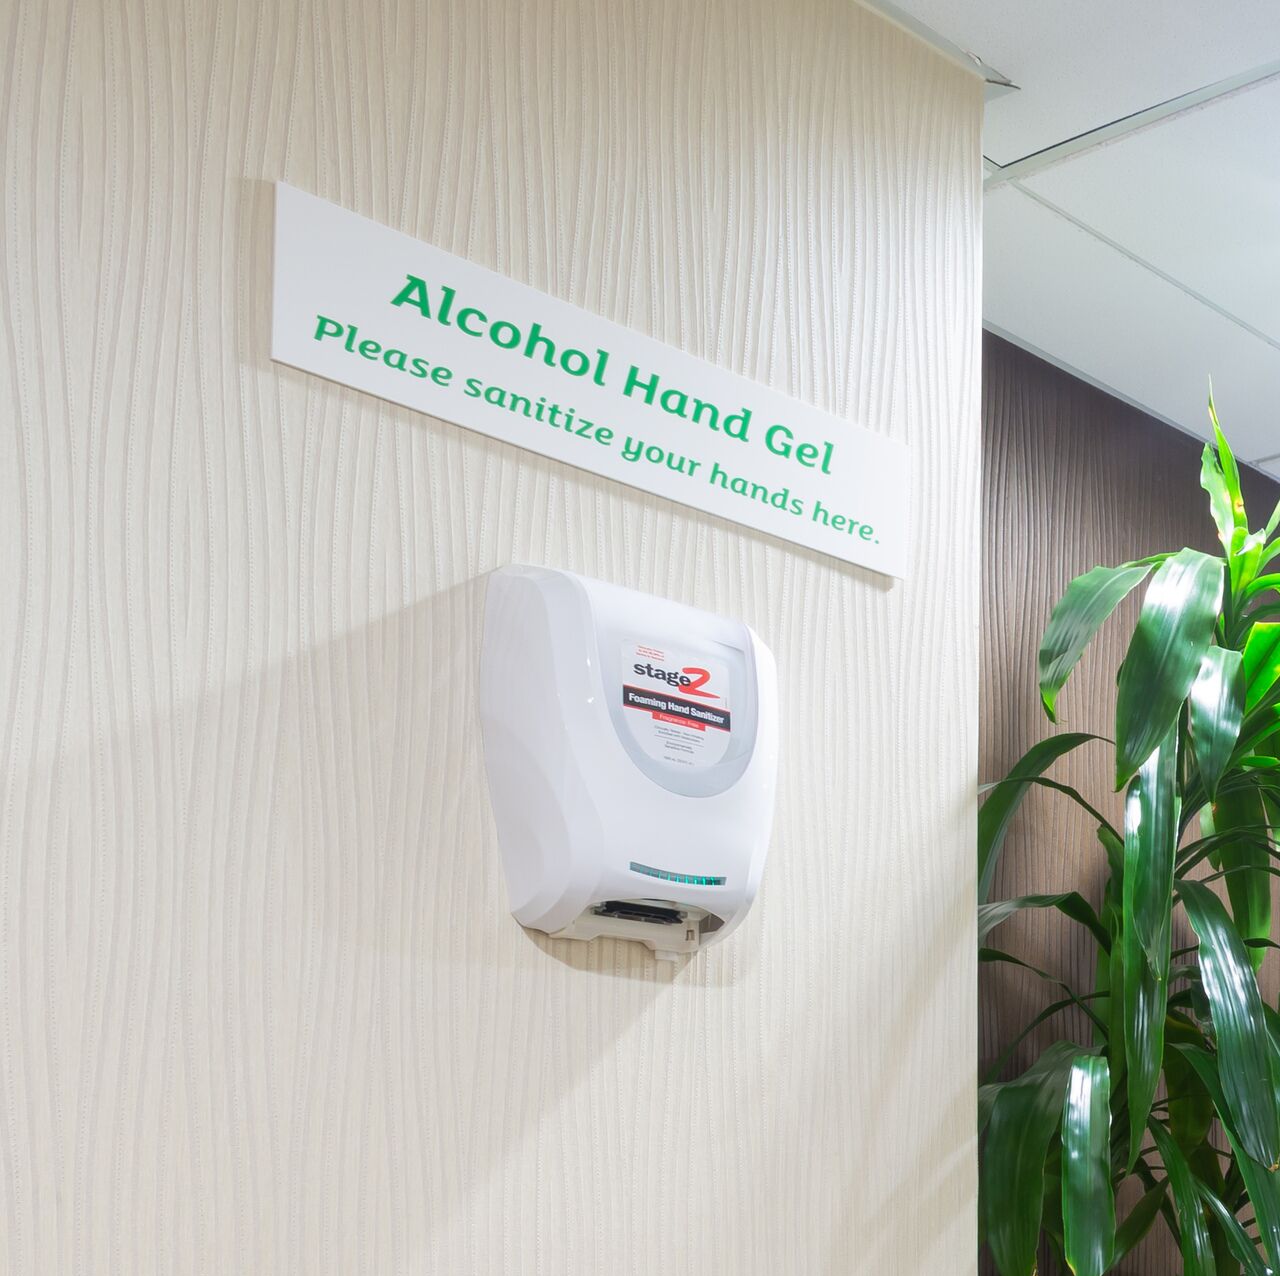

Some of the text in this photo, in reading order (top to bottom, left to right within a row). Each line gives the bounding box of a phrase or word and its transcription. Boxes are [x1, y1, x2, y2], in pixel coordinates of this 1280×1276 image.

[313, 314, 881, 546] Please sanitize your hands here.
[390, 273, 834, 475] Alcohol Hand Gel
[628, 693, 725, 724] Foaming Hand Sanitizer
